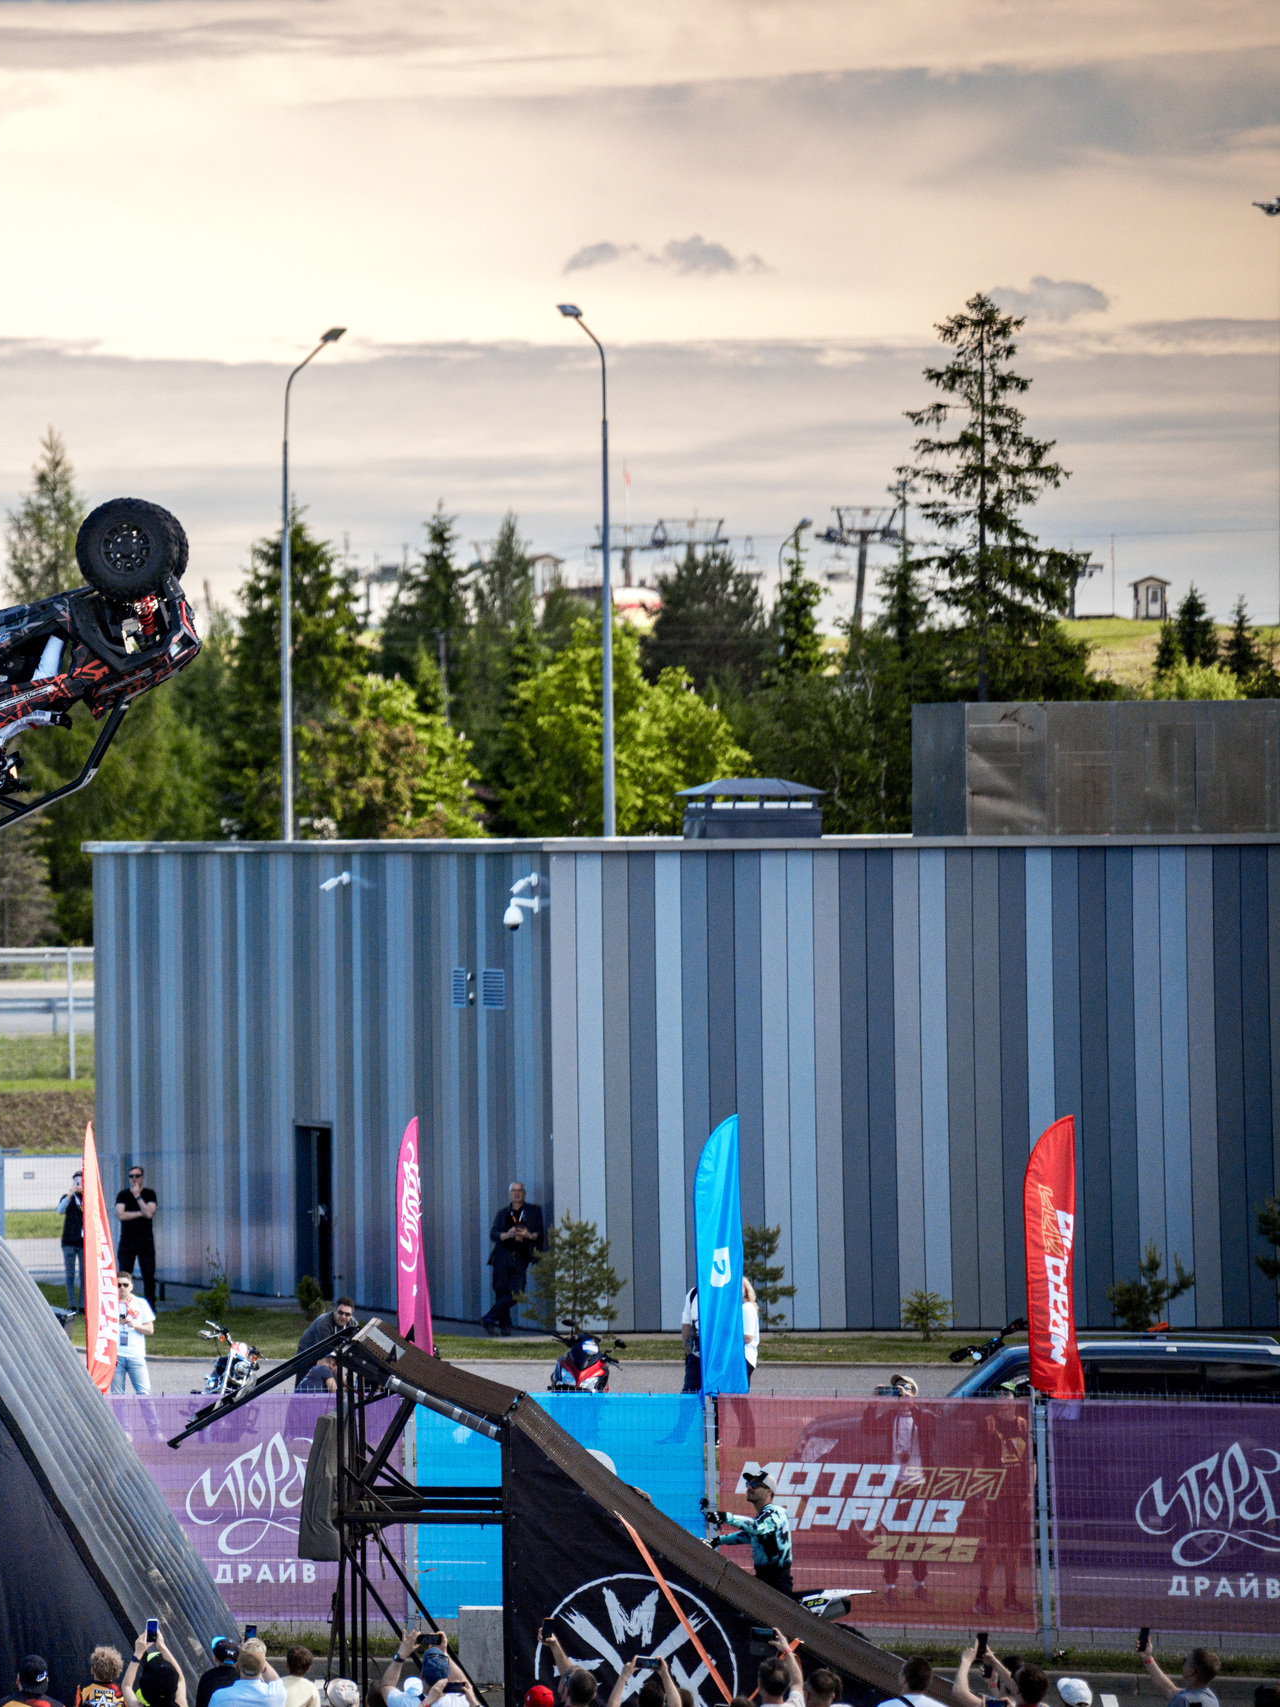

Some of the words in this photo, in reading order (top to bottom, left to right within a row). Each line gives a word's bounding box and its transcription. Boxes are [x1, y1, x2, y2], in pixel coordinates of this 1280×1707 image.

[867, 1534, 980, 1563] 2026
[214, 1558, 316, 1584] ДРАЙВ
[1168, 1572, 1280, 1599] ДРАЙВ
